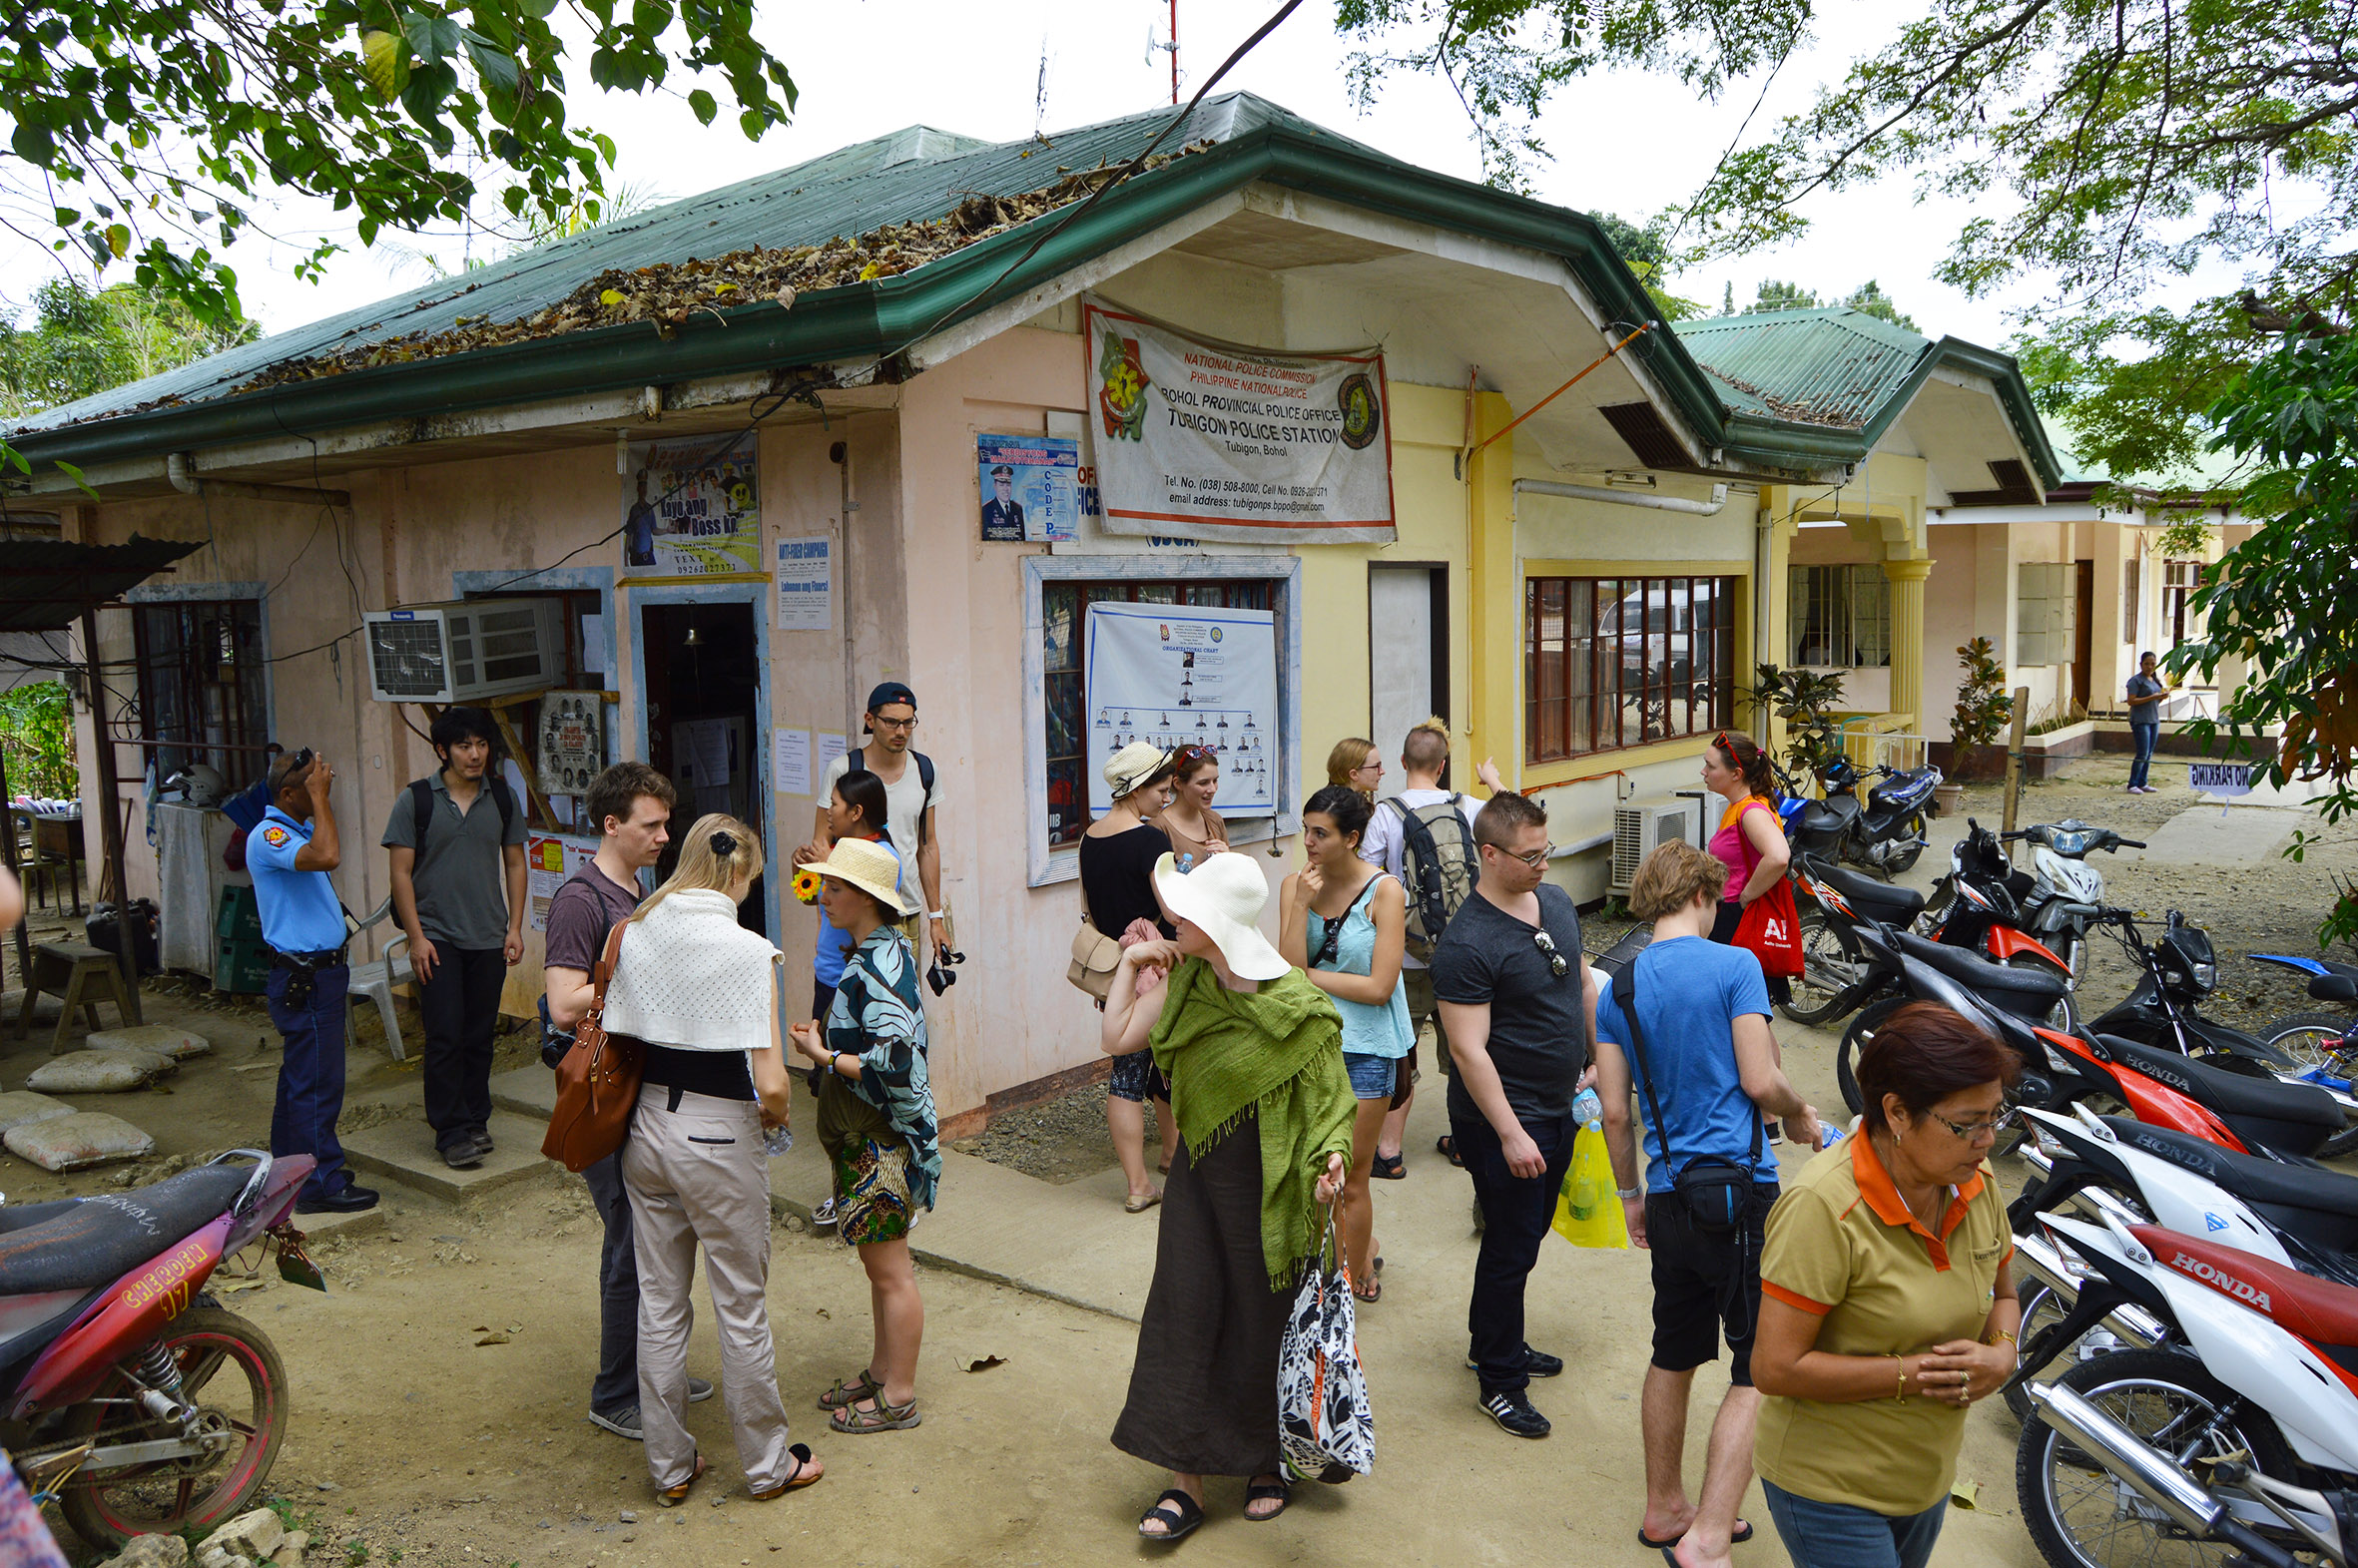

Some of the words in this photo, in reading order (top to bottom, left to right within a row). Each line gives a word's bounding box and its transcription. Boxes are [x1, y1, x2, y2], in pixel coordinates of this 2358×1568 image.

[1184, 352, 1233, 372] NATIONAL
[1235, 363, 1268, 378] POLICE
[1270, 367, 1318, 384] COMMISSION
[1190, 371, 1240, 390] PHILIPPINE
[1161, 388, 1199, 406] BOHOL
[1202, 394, 1262, 416] PROVINCIAL
[1266, 404, 1300, 419] POLICE
[1302, 408, 1341, 421] OFFICE
[1168, 408, 1228, 435] TUBIGON
[1230, 420, 1280, 441] POLICE
[1283, 426, 1340, 444] STATION
[1225, 440, 1262, 456] Tubigon,
[1264, 443, 1288, 457] Bohol
[1165, 475, 1178, 487] Tel.
[1181, 477, 1196, 489] No.
[1199, 479, 1221, 493] (038)
[1223, 480, 1260, 495] 508-8000,
[1262, 484, 1277, 495] Cell
[1277, 486, 1289, 496] No.
[686, 498, 707, 517] ang
[1169, 493, 1191, 504] email
[1193, 495, 1231, 507] address:
[692, 518, 722, 536] Boss
[674, 555, 703, 564] TEXT
[1764, 917, 1787, 941] A!
[2125, 1052, 2190, 1092] HONDA
[2133, 1132, 2216, 1177] HONDA
[121, 1243, 208, 1308] CHERDEN
[2170, 1251, 2272, 1313] HONDA
[160, 1279, 189, 1321] 17
